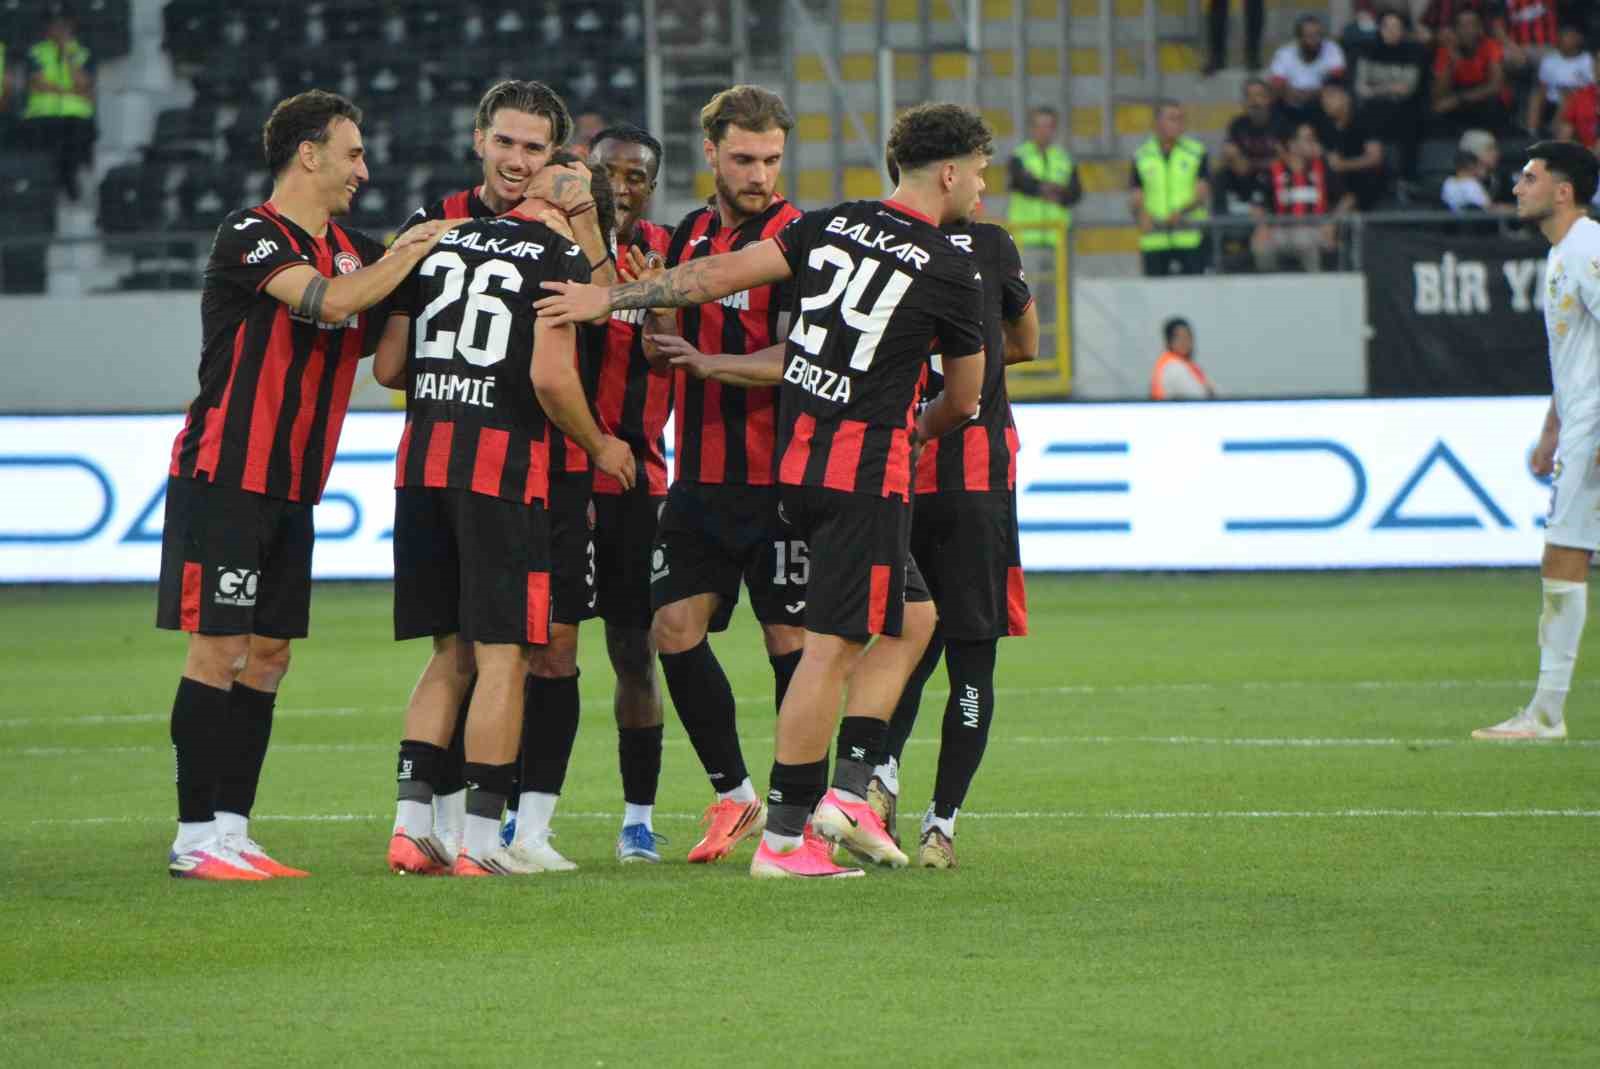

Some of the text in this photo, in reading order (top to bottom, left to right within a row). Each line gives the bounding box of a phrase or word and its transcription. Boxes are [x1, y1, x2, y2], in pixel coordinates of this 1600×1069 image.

[440, 229, 545, 260] BALKAR
[826, 216, 931, 271] BALKAR
[415, 250, 524, 367] 26
[789, 244, 914, 372] 24
[1412, 251, 1490, 316] BİR
[773, 540, 810, 585] 15
[959, 684, 979, 729] Miller
